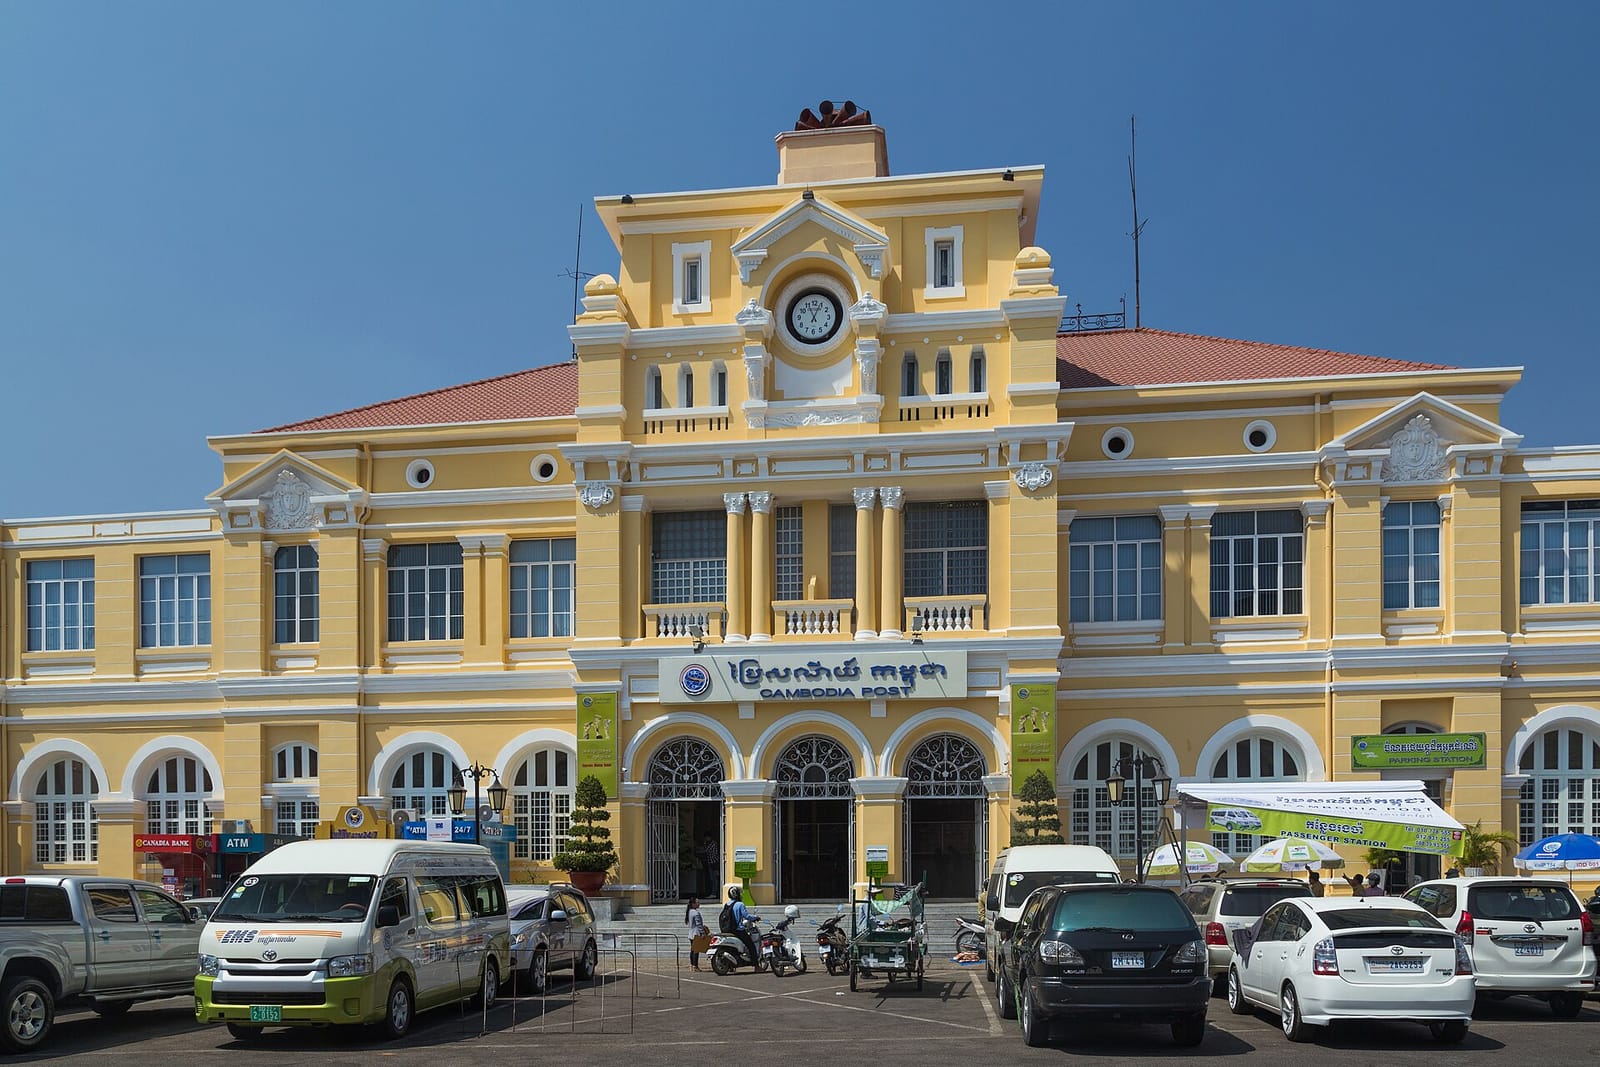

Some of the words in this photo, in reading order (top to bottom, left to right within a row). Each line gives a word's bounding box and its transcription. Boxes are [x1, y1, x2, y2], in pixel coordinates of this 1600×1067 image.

[760, 687, 855, 698] CAMBODIA
[862, 686, 911, 697] POST
[142, 839, 170, 847] CANADIA
[226, 838, 249, 848] ATM
[1280, 830, 1340, 843] PASSENGER
[1343, 836, 1387, 848] STATION
[221, 930, 259, 944] EMS
